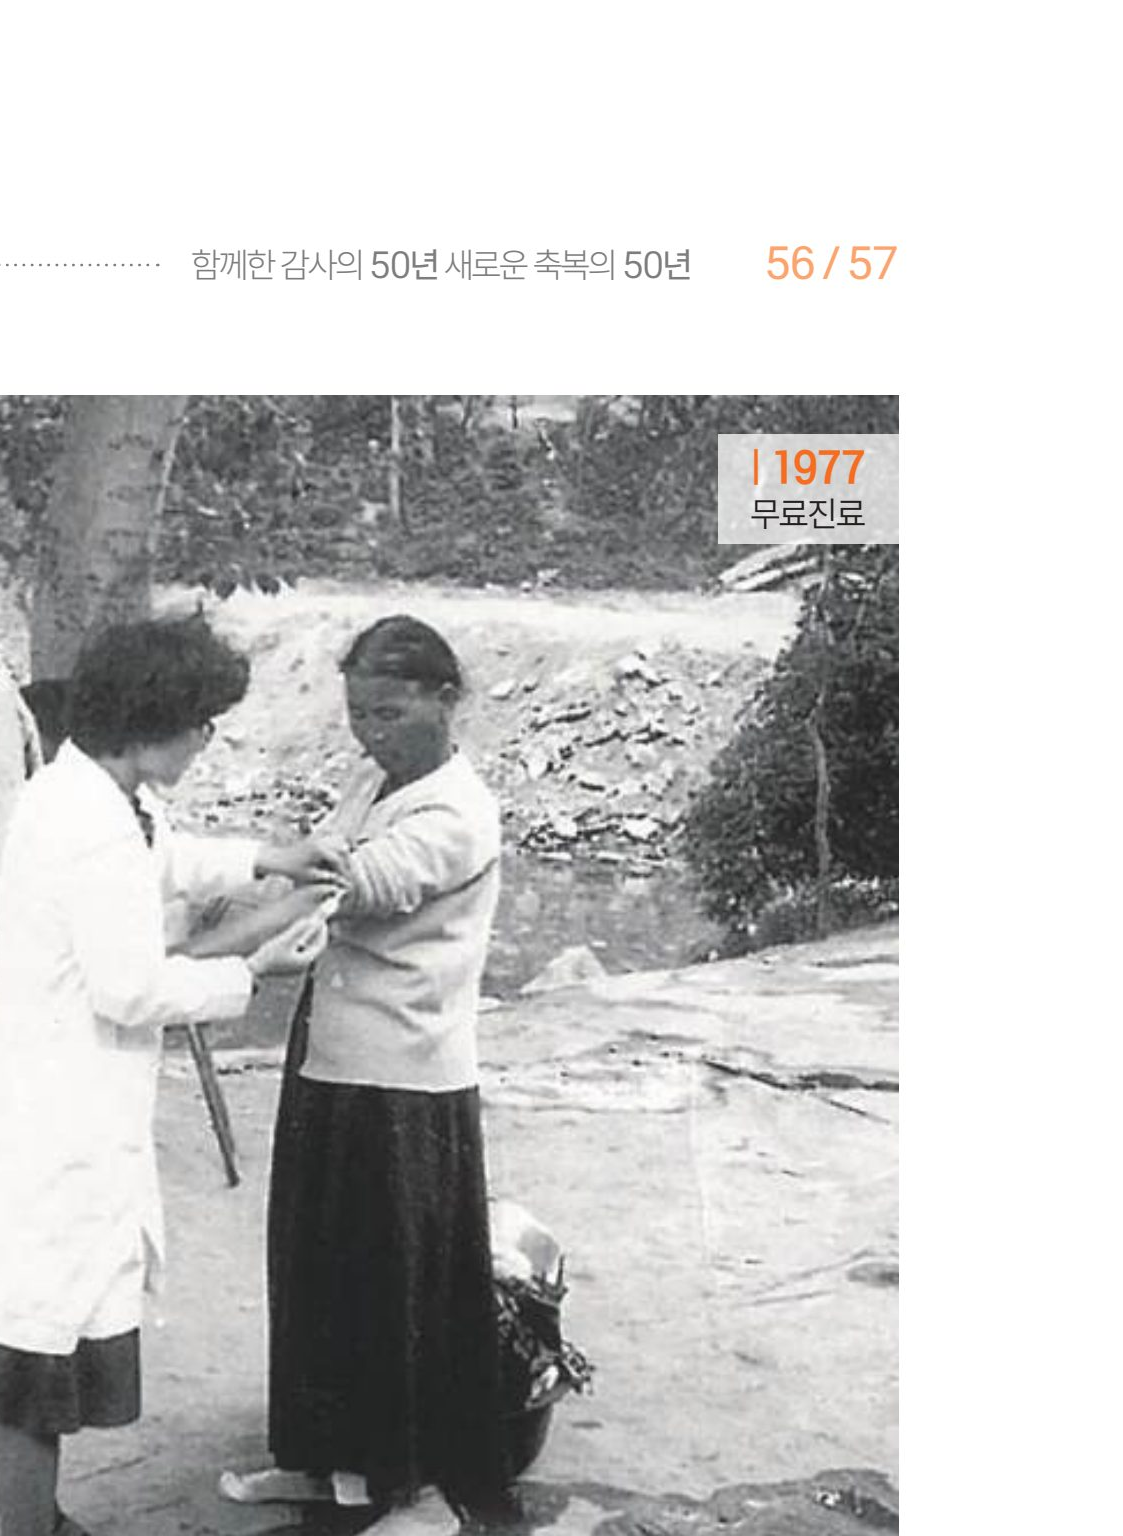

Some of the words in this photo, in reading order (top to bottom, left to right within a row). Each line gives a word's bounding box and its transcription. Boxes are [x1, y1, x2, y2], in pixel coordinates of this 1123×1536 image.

[191, 249, 276, 281] 함께한
[281, 249, 362, 281] 감사의
[371, 248, 438, 281] 50년
[444, 249, 529, 281] 새로운
[533, 248, 614, 281] 축복의
[624, 248, 691, 281] 50년
[766, 245, 815, 281] 56
[849, 245, 898, 281] 57
